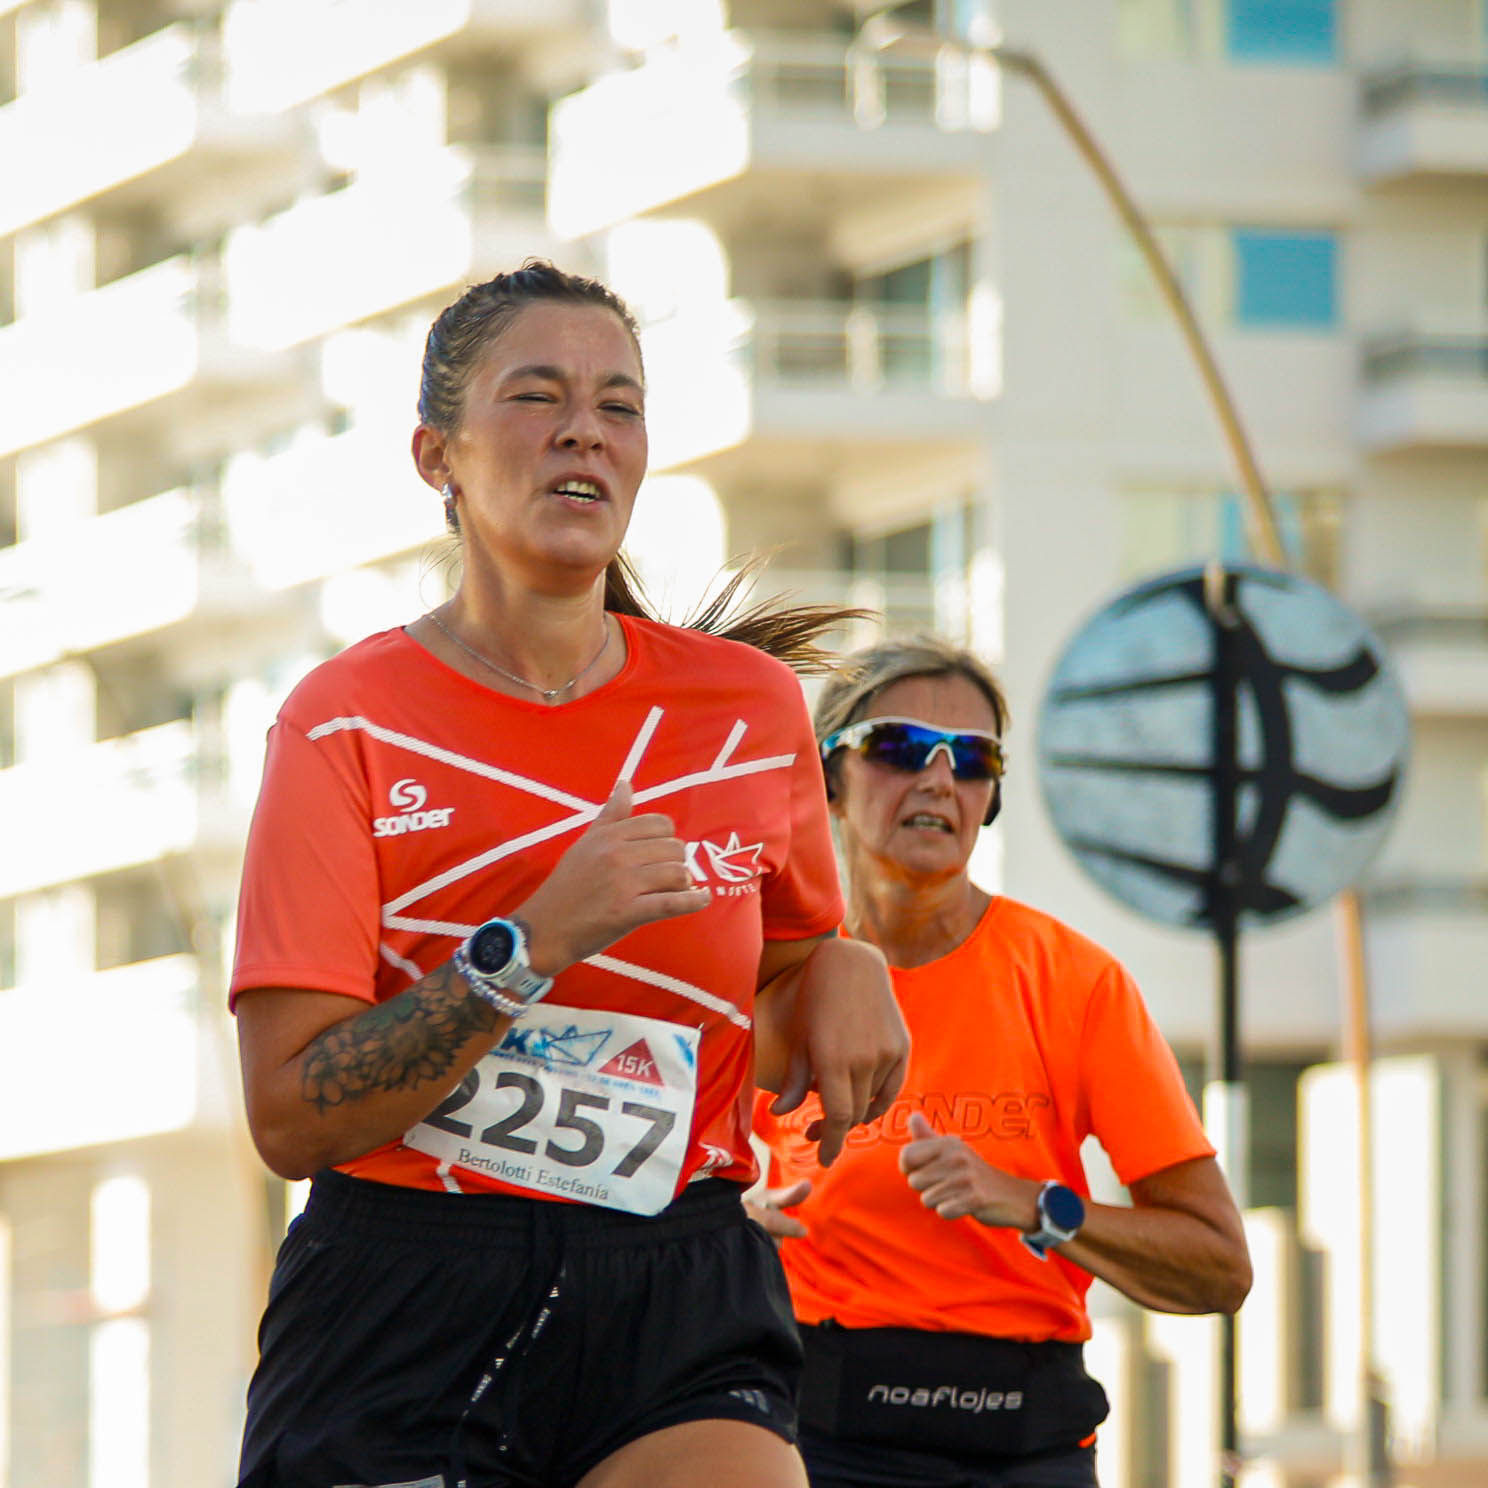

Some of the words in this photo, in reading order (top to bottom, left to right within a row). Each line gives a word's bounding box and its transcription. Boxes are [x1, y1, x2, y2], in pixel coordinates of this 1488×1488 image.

[616, 1053, 653, 1078] 15K
[422, 1067, 677, 1179] 2257
[457, 1148, 534, 1182] Bertolotti
